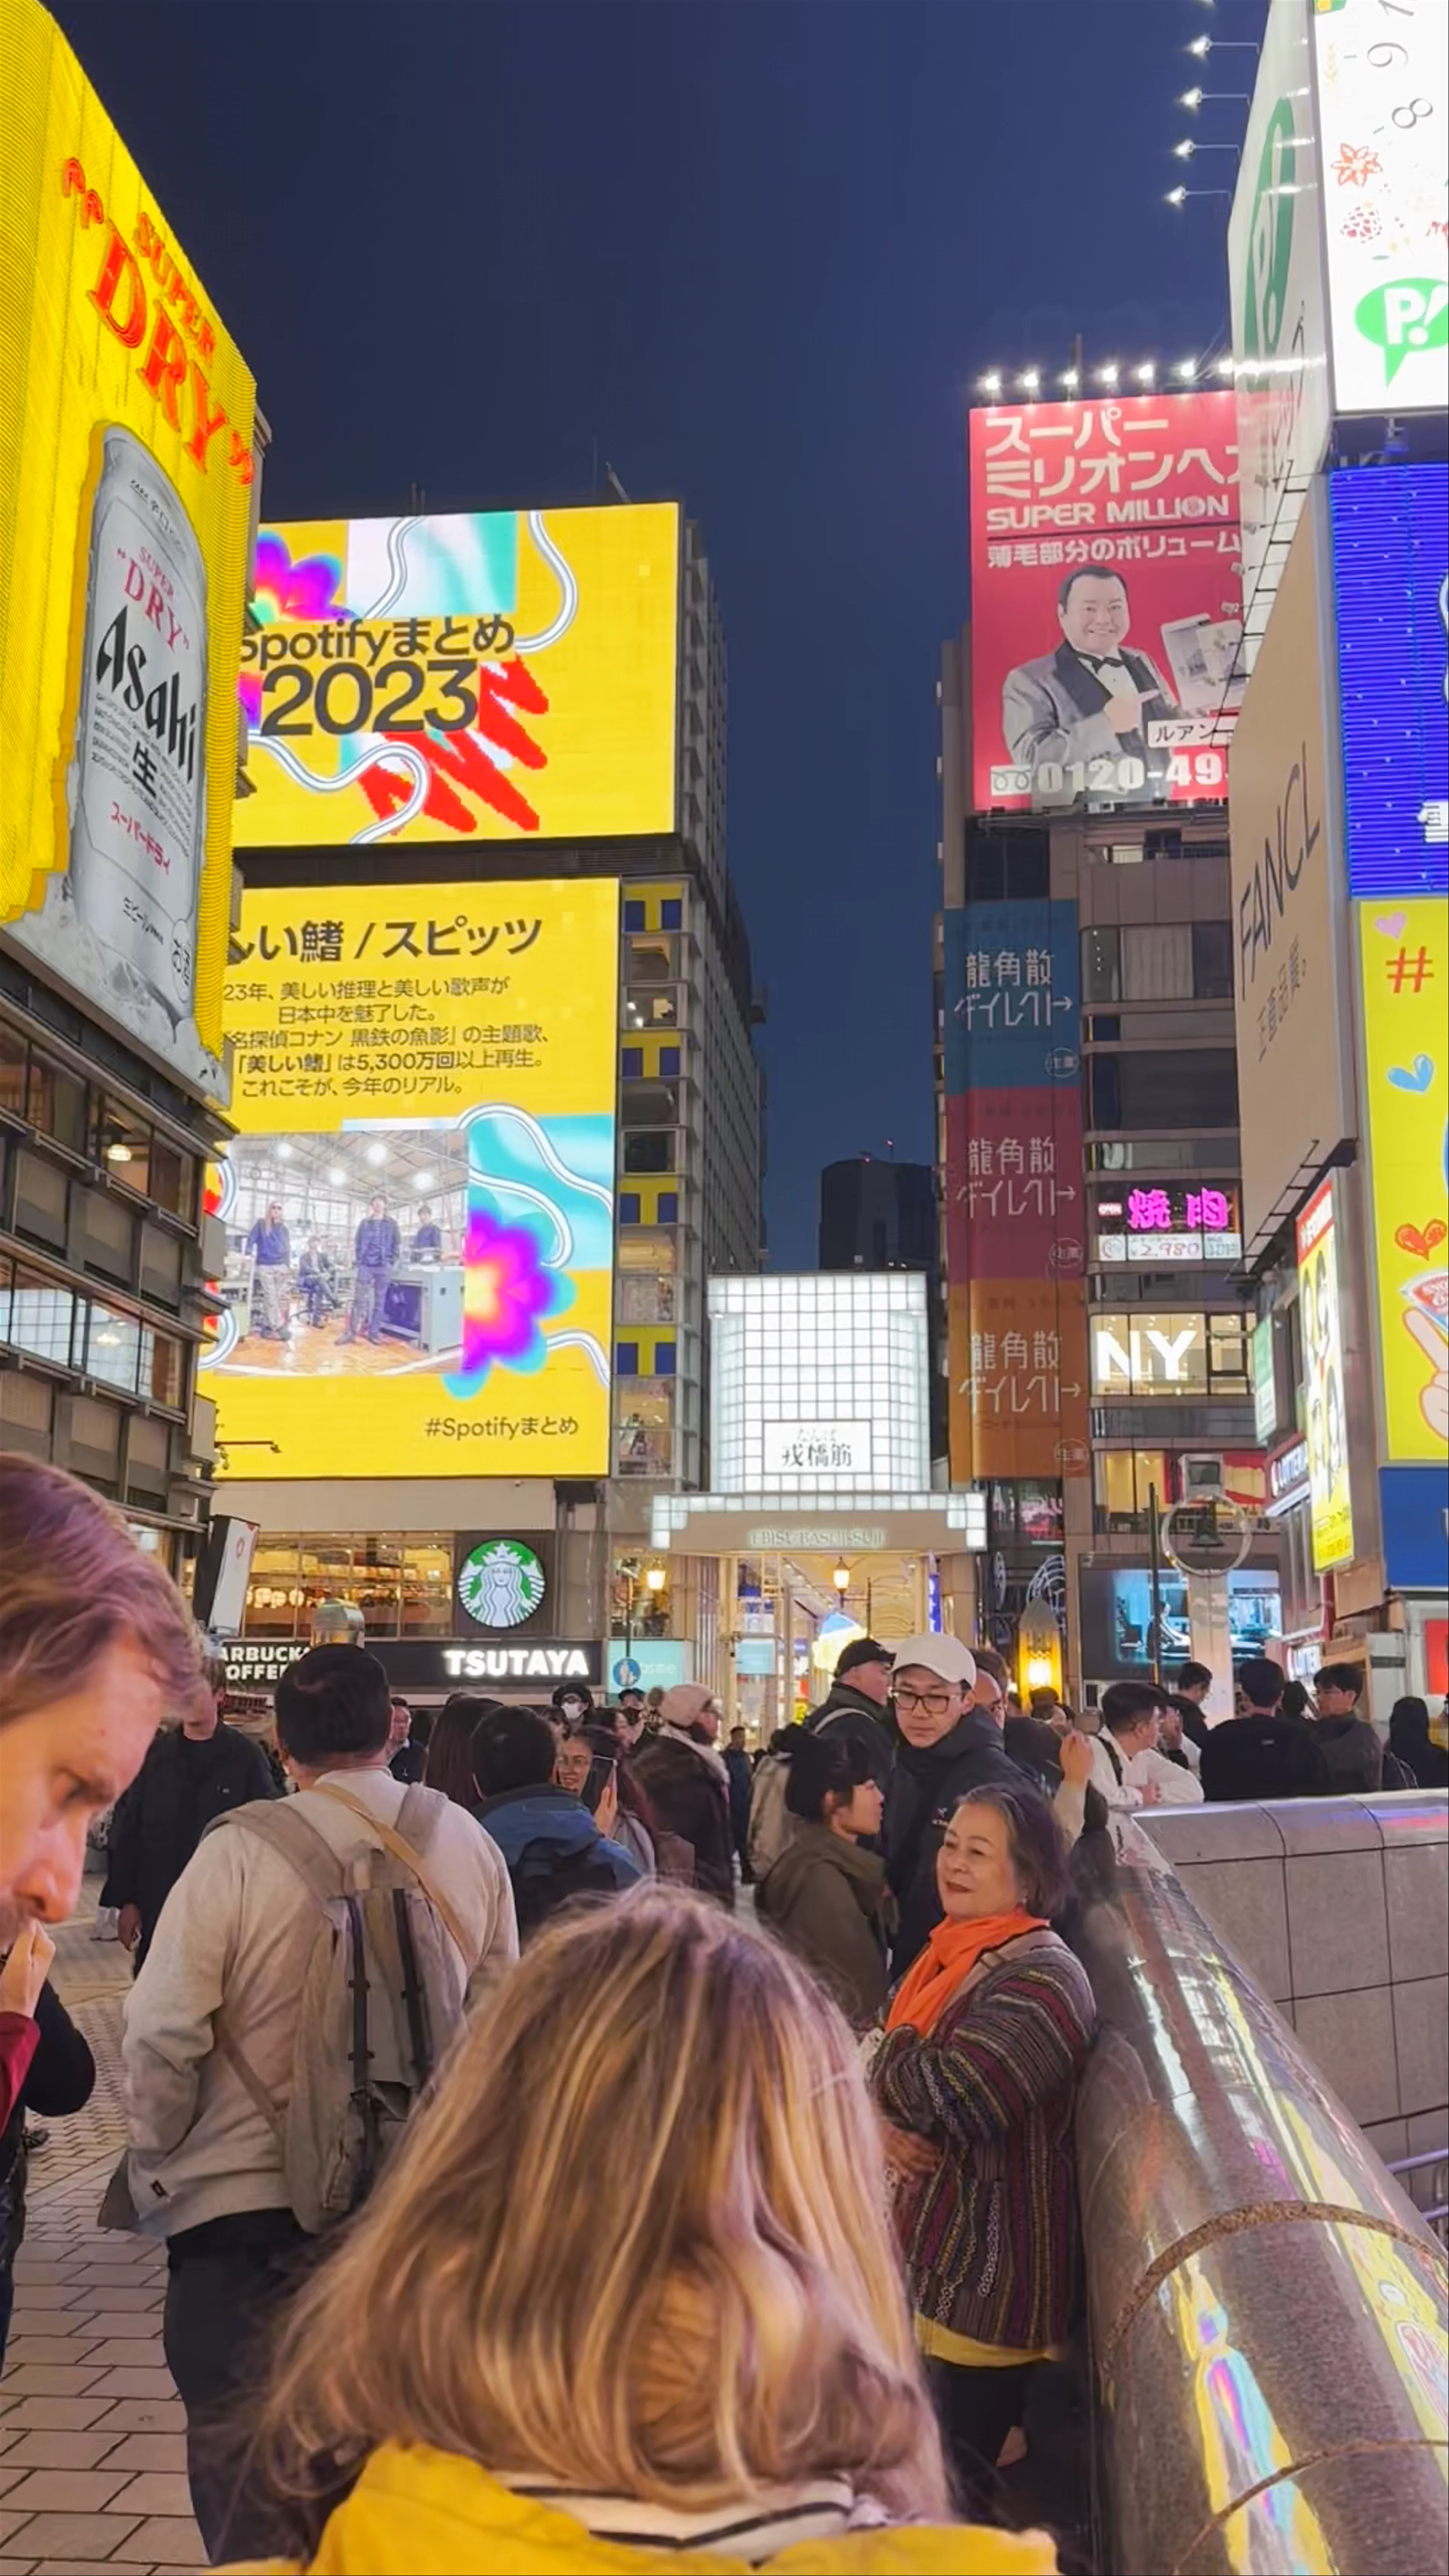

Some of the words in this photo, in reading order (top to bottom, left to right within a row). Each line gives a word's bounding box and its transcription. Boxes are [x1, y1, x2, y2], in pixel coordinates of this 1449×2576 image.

[134, 211, 216, 368] SUPER
[986, 407, 1169, 457] スーパー
[986, 503, 1096, 531] SUPER
[1106, 495, 1229, 523] MILLION
[96, 605, 197, 783] Asahi
[260, 658, 479, 736] 2023
[1240, 740, 1321, 1002] FANCL
[382, 915, 542, 959] スピッツ
[966, 949, 1053, 988] 龍角散
[278, 1003, 435, 1024] 日本中を魅了した。
[954, 991, 1052, 1031] ダイレクト
[243, 1075, 462, 1097] これこそが、今年のリアル。
[969, 1136, 1054, 1175] 龍角散
[956, 1180, 1055, 1218] ダイレクト
[971, 1329, 1061, 1370] 龍角散
[1096, 1330, 1197, 1382] NY
[958, 1375, 1060, 1416] ダイレクト
[424, 1416, 579, 1441] #Spotifyまとめ
[781, 1443, 852, 1467] 戎橋筋
[445, 1650, 589, 1676] TSUTAYA
